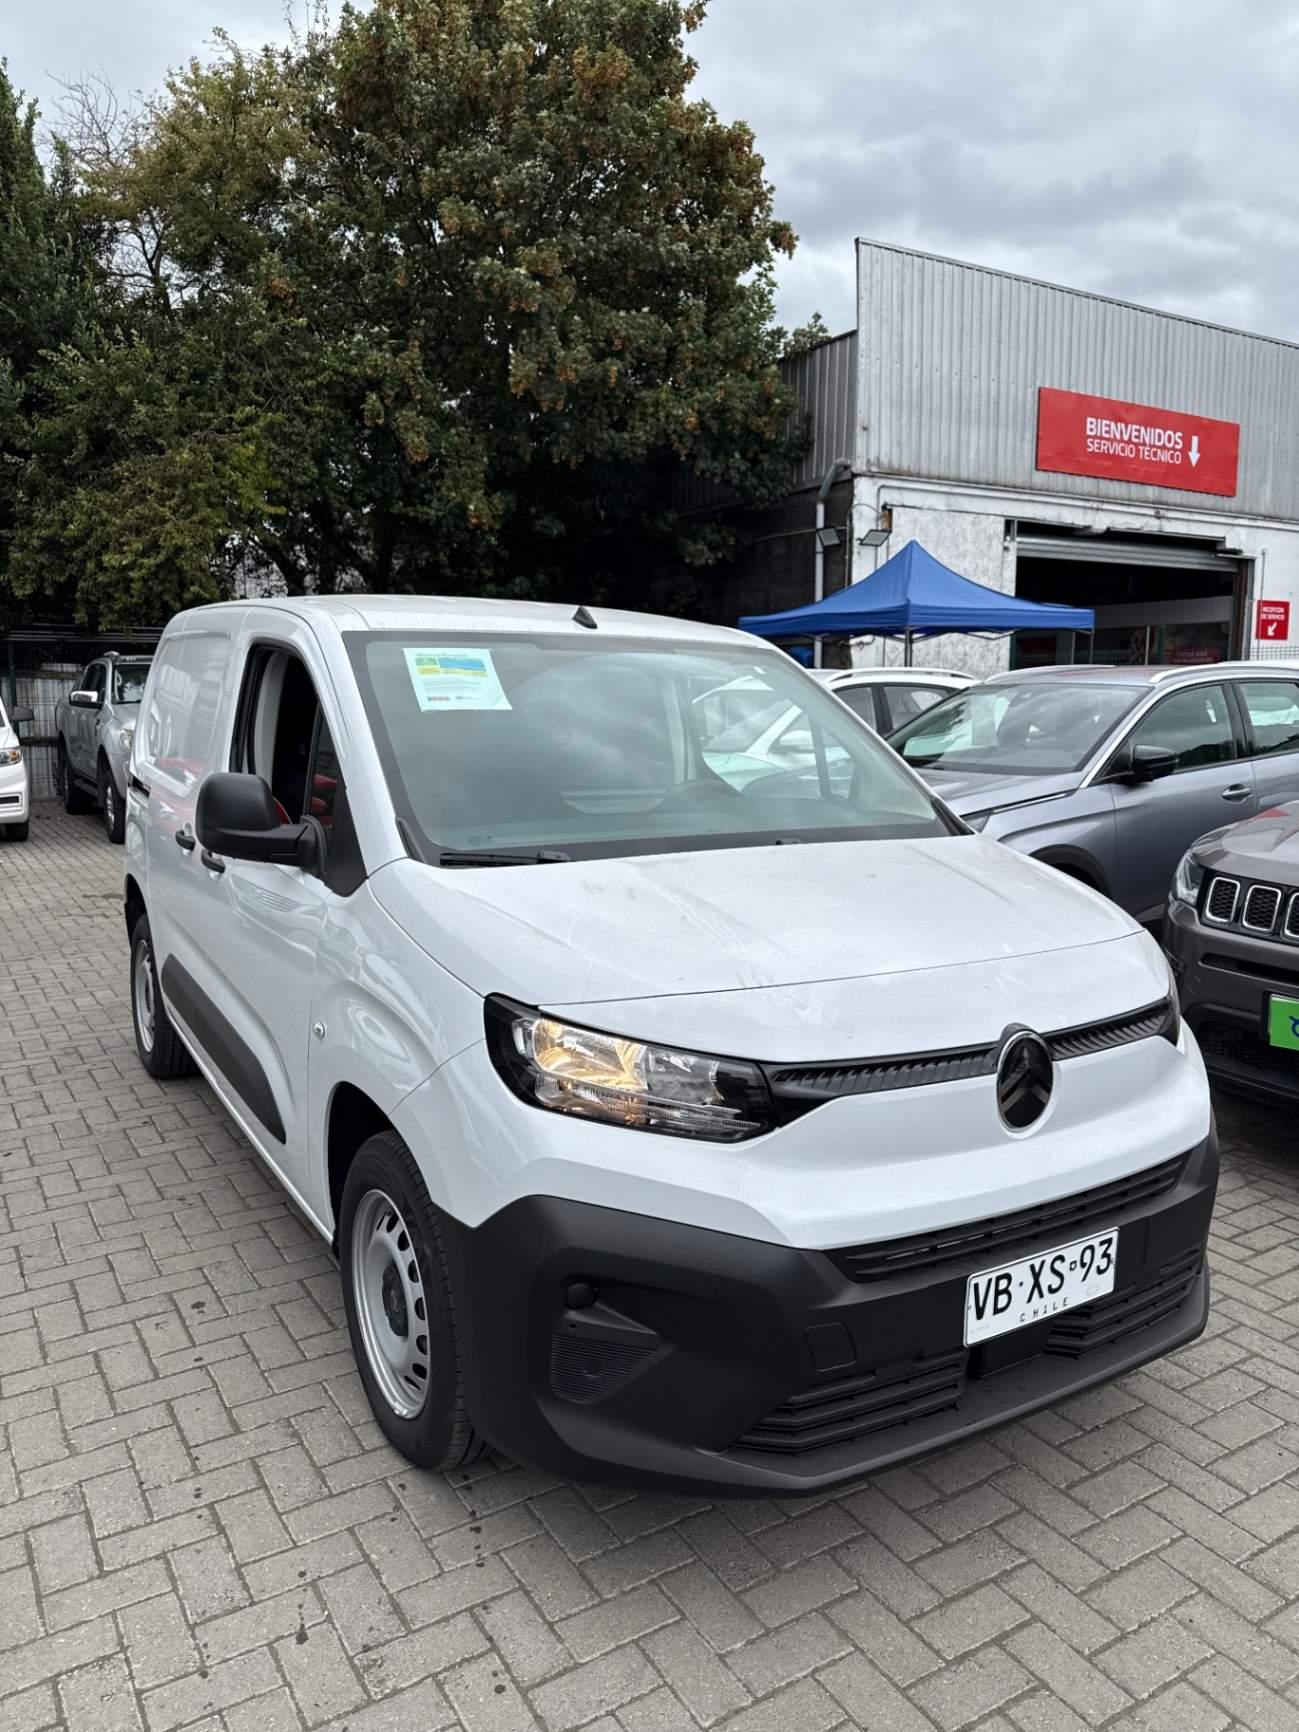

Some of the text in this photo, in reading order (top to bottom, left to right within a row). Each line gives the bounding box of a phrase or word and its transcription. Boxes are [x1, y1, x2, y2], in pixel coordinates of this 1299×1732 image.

[1086, 417, 1183, 449] BIENVENIDOS
[1087, 438, 1182, 464] SERVICIO TÉCNICO
[1019, 1297, 1068, 1322] CHILE
